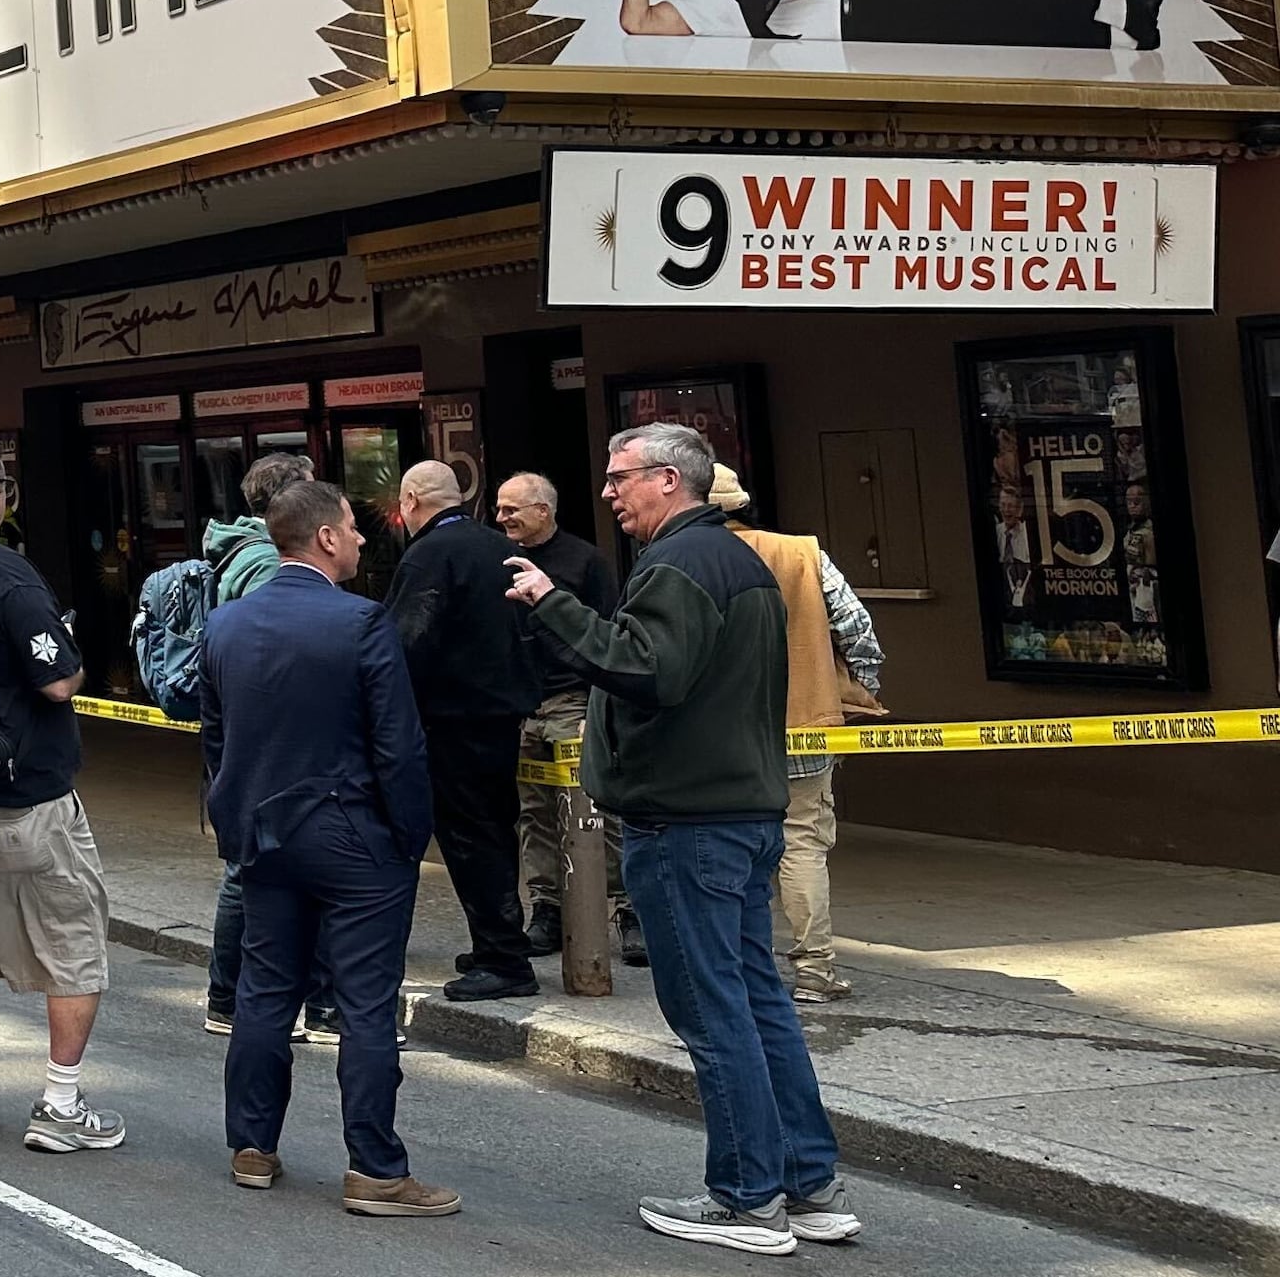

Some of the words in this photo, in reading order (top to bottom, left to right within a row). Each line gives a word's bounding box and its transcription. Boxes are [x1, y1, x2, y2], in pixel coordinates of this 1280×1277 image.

[657, 173, 731, 290] 9
[742, 176, 1118, 232] WINNER!
[743, 235, 815, 250] TONY
[970, 236, 1118, 252] INCLUDING
[742, 255, 869, 290] BEST
[895, 256, 1117, 291] MUSICAL
[432, 403, 473, 420] HELLO
[1028, 434, 1104, 457] HELLO
[1024, 457, 1115, 566] 15
[1044, 568, 1066, 579] THE
[1067, 568, 1098, 579] BOOK
[1100, 568, 1116, 579] OF
[1045, 580, 1119, 596] MORMON
[1018, 725, 1029, 743] DO
[1031, 724, 1045, 743] NOT
[1047, 723, 1072, 742] CROSS
[1113, 720, 1132, 740] FIRE
[1156, 718, 1167, 738] DO
[1169, 717, 1186, 737] NOT
[1188, 716, 1216, 737] CROSS
